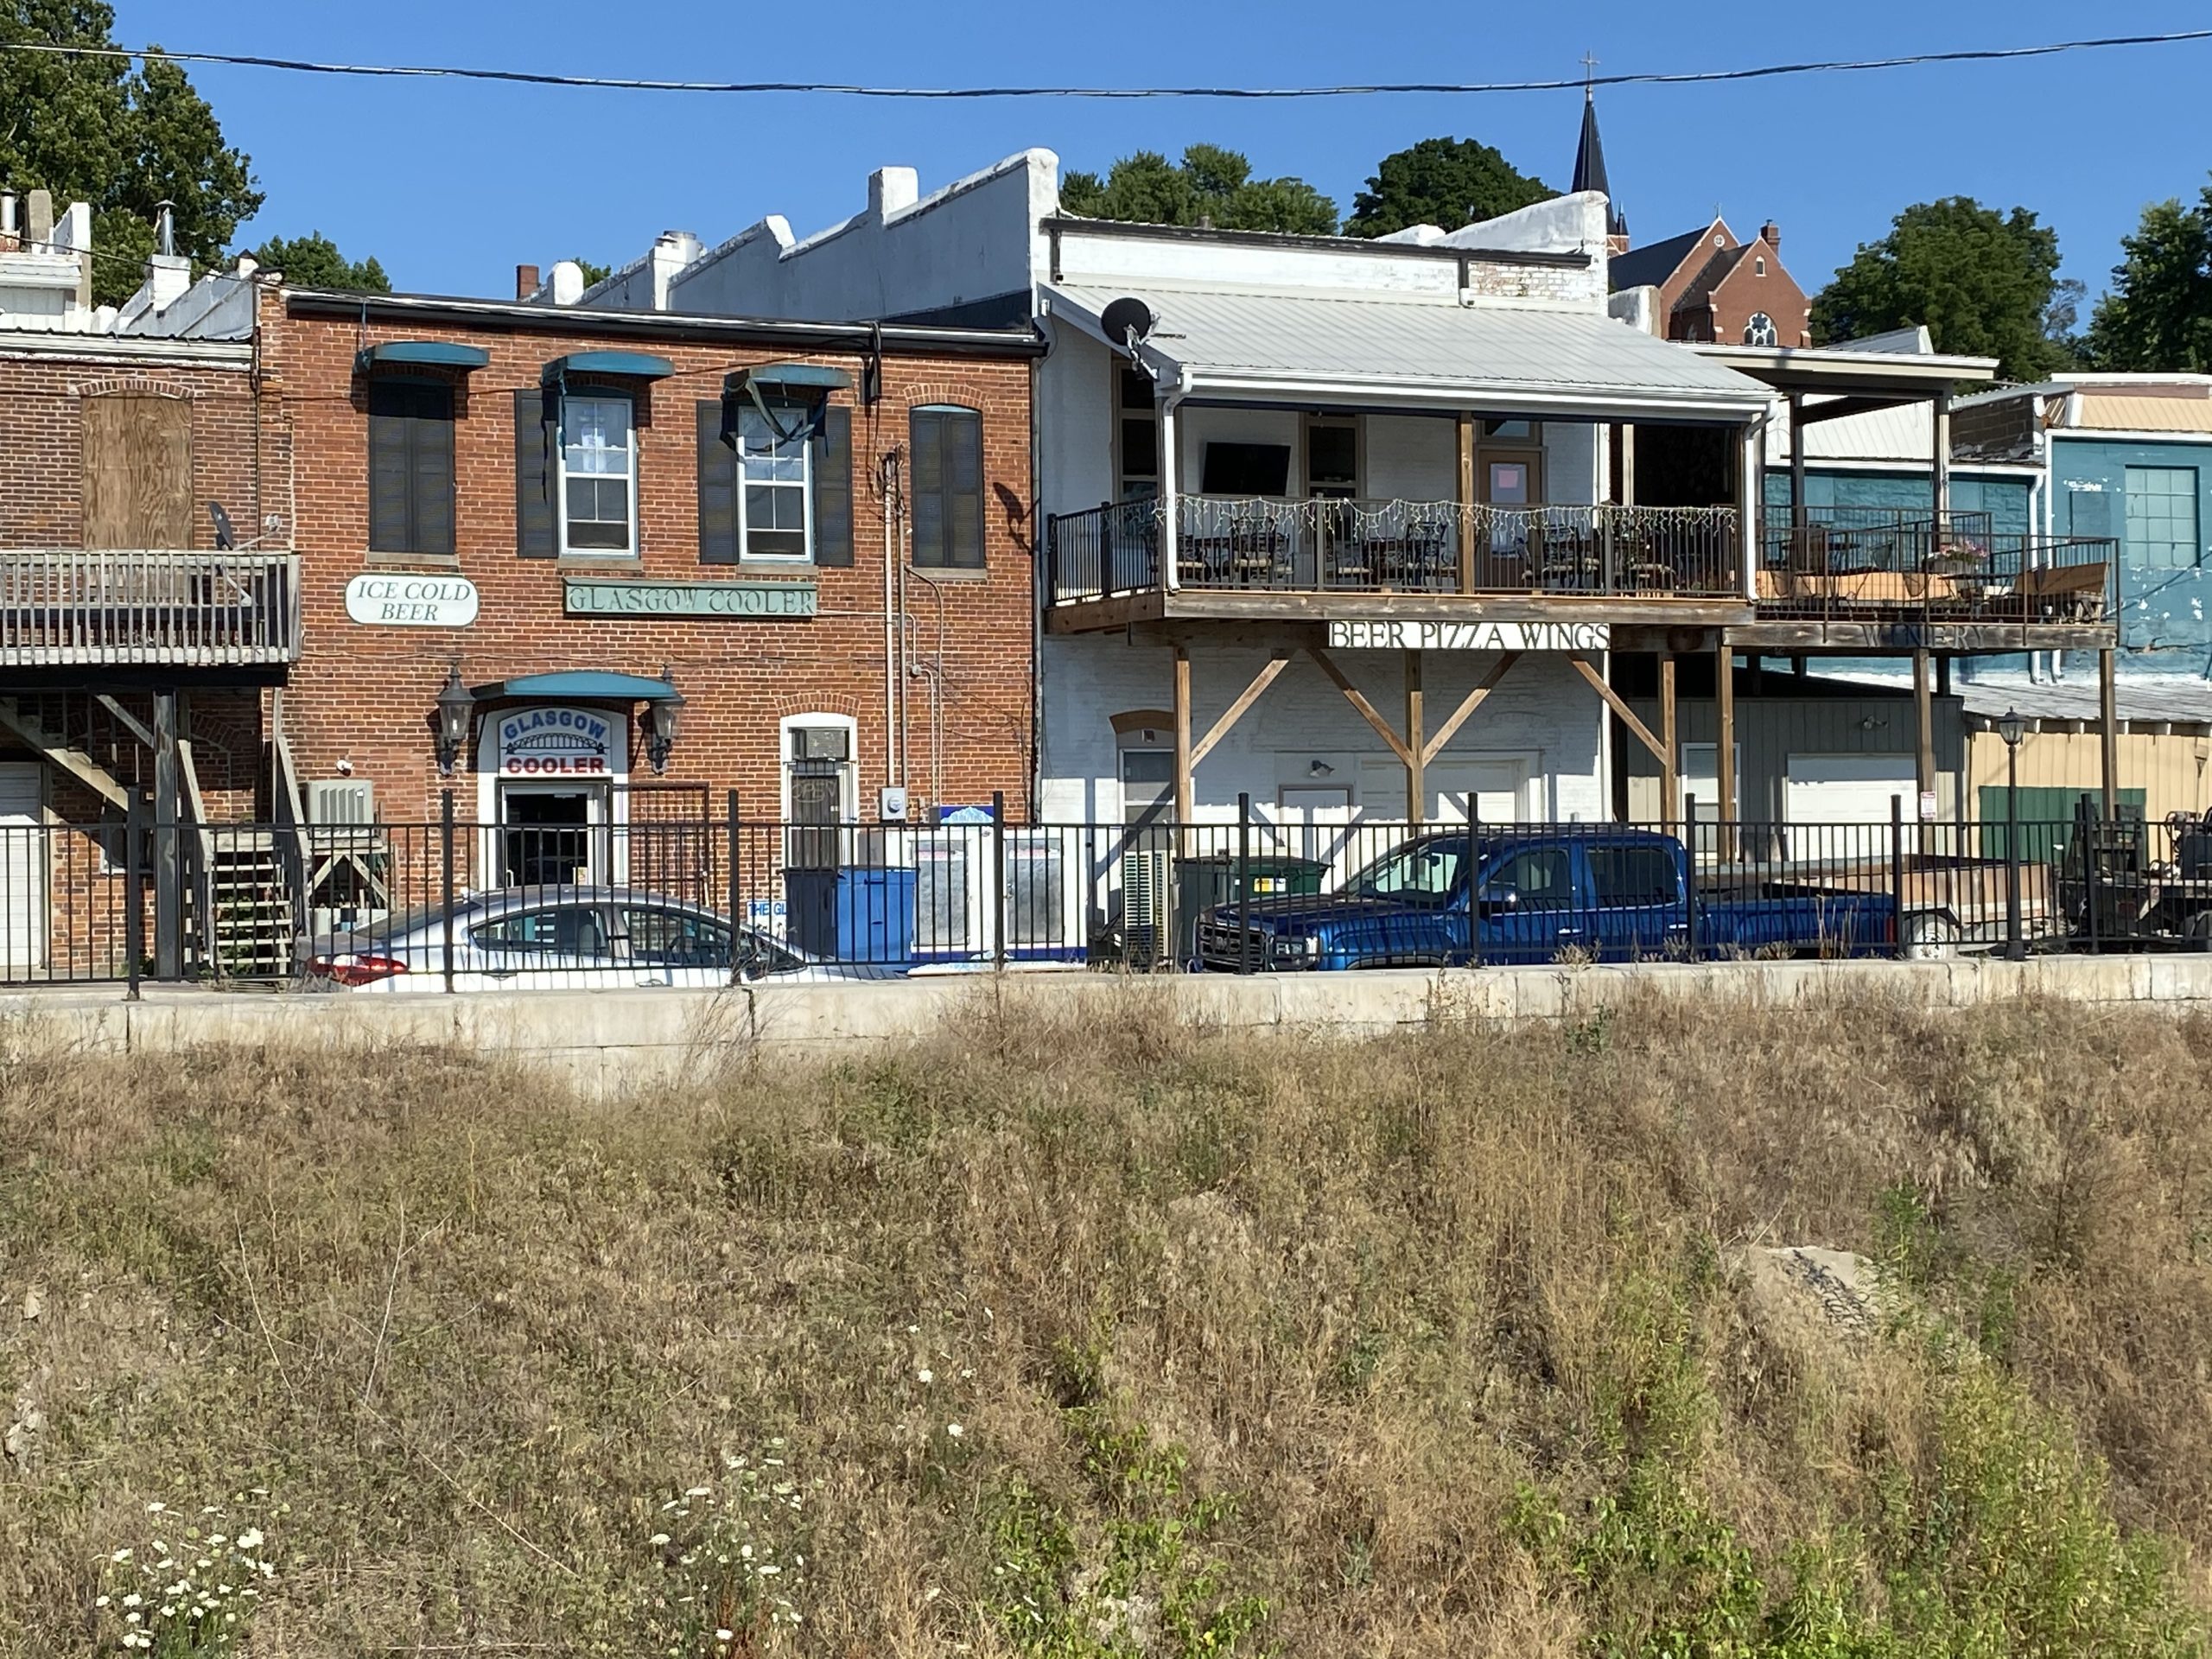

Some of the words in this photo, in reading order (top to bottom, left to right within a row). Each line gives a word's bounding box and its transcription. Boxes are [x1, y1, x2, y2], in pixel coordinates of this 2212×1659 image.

[357, 581, 398, 599] ICE
[404, 582, 471, 601] COLD
[569, 587, 697, 612] GLASGOW
[708, 589, 815, 614] COOLER
[380, 602, 438, 621] BEER
[1329, 621, 1407, 648] BEER
[1420, 621, 1506, 649] PIZZA
[1517, 622, 1611, 650] WINGS
[1861, 624, 1987, 650] WINERY
[504, 710, 607, 740] GLASGOW
[506, 757, 605, 773] COOLER
[748, 902, 770, 917] THE
